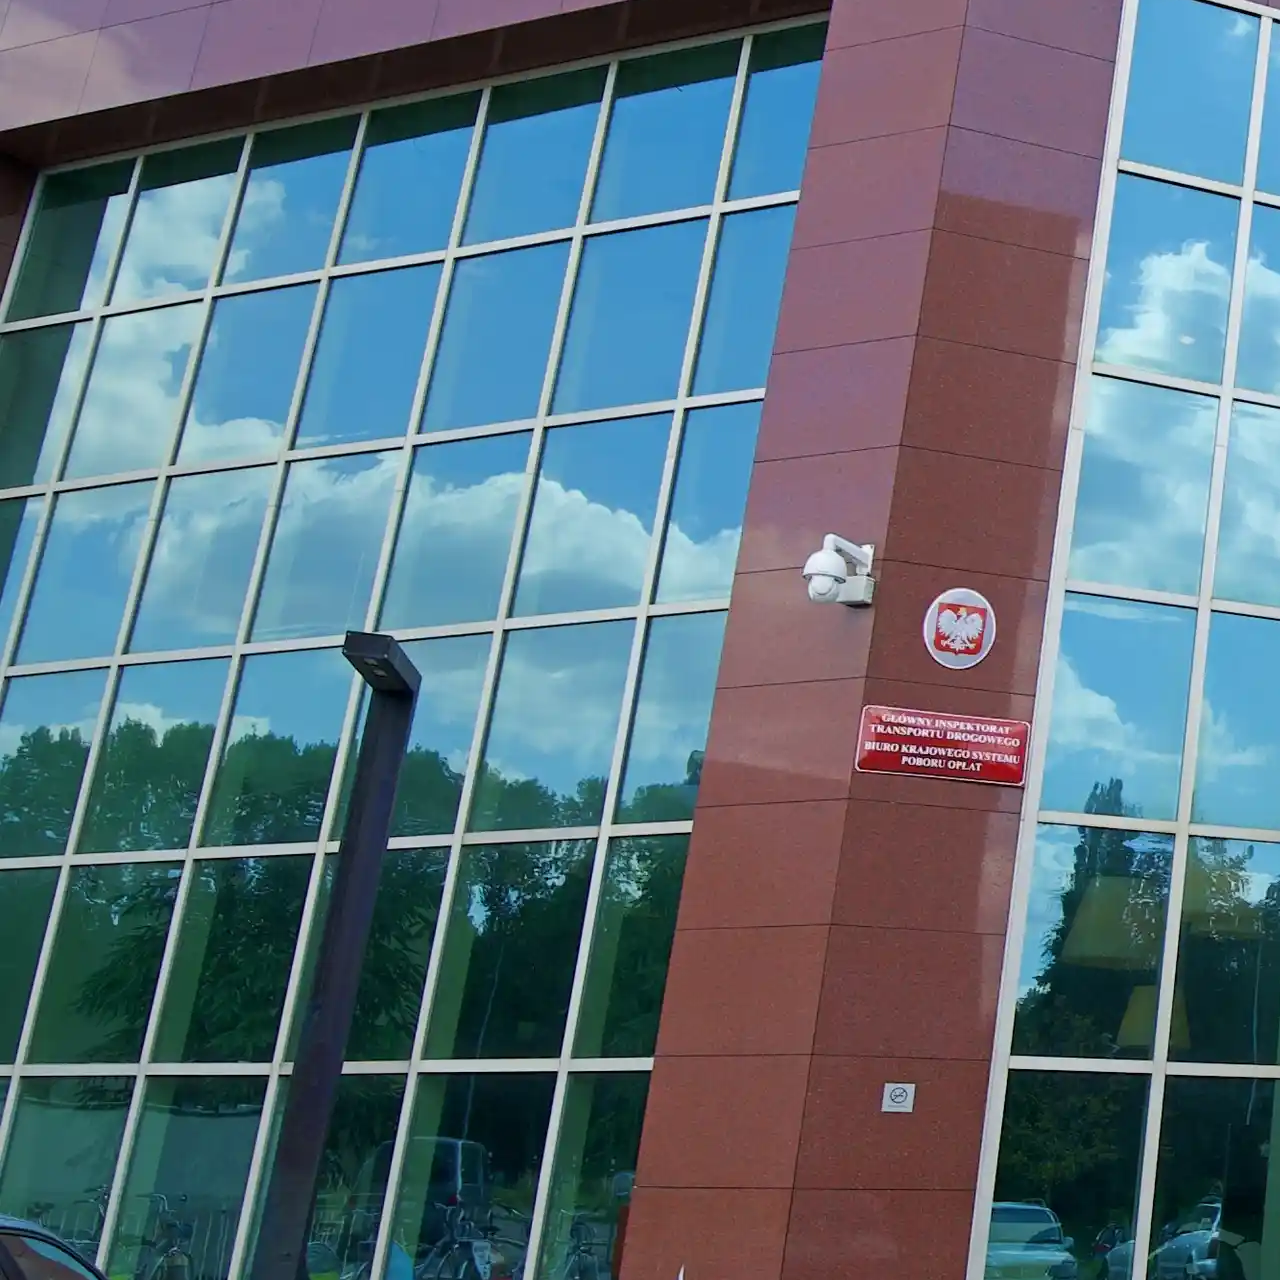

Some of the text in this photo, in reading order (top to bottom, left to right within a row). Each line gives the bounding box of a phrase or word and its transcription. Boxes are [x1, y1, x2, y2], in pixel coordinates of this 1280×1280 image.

[868, 724, 1020, 747] TRANSPORTU DROGOWEGO
[935, 719, 1012, 735] INSPEKTORAT
[864, 740, 1020, 765] BIURO KRAJOWEGO SYSTEMU
[901, 756, 946, 769] POBORU
